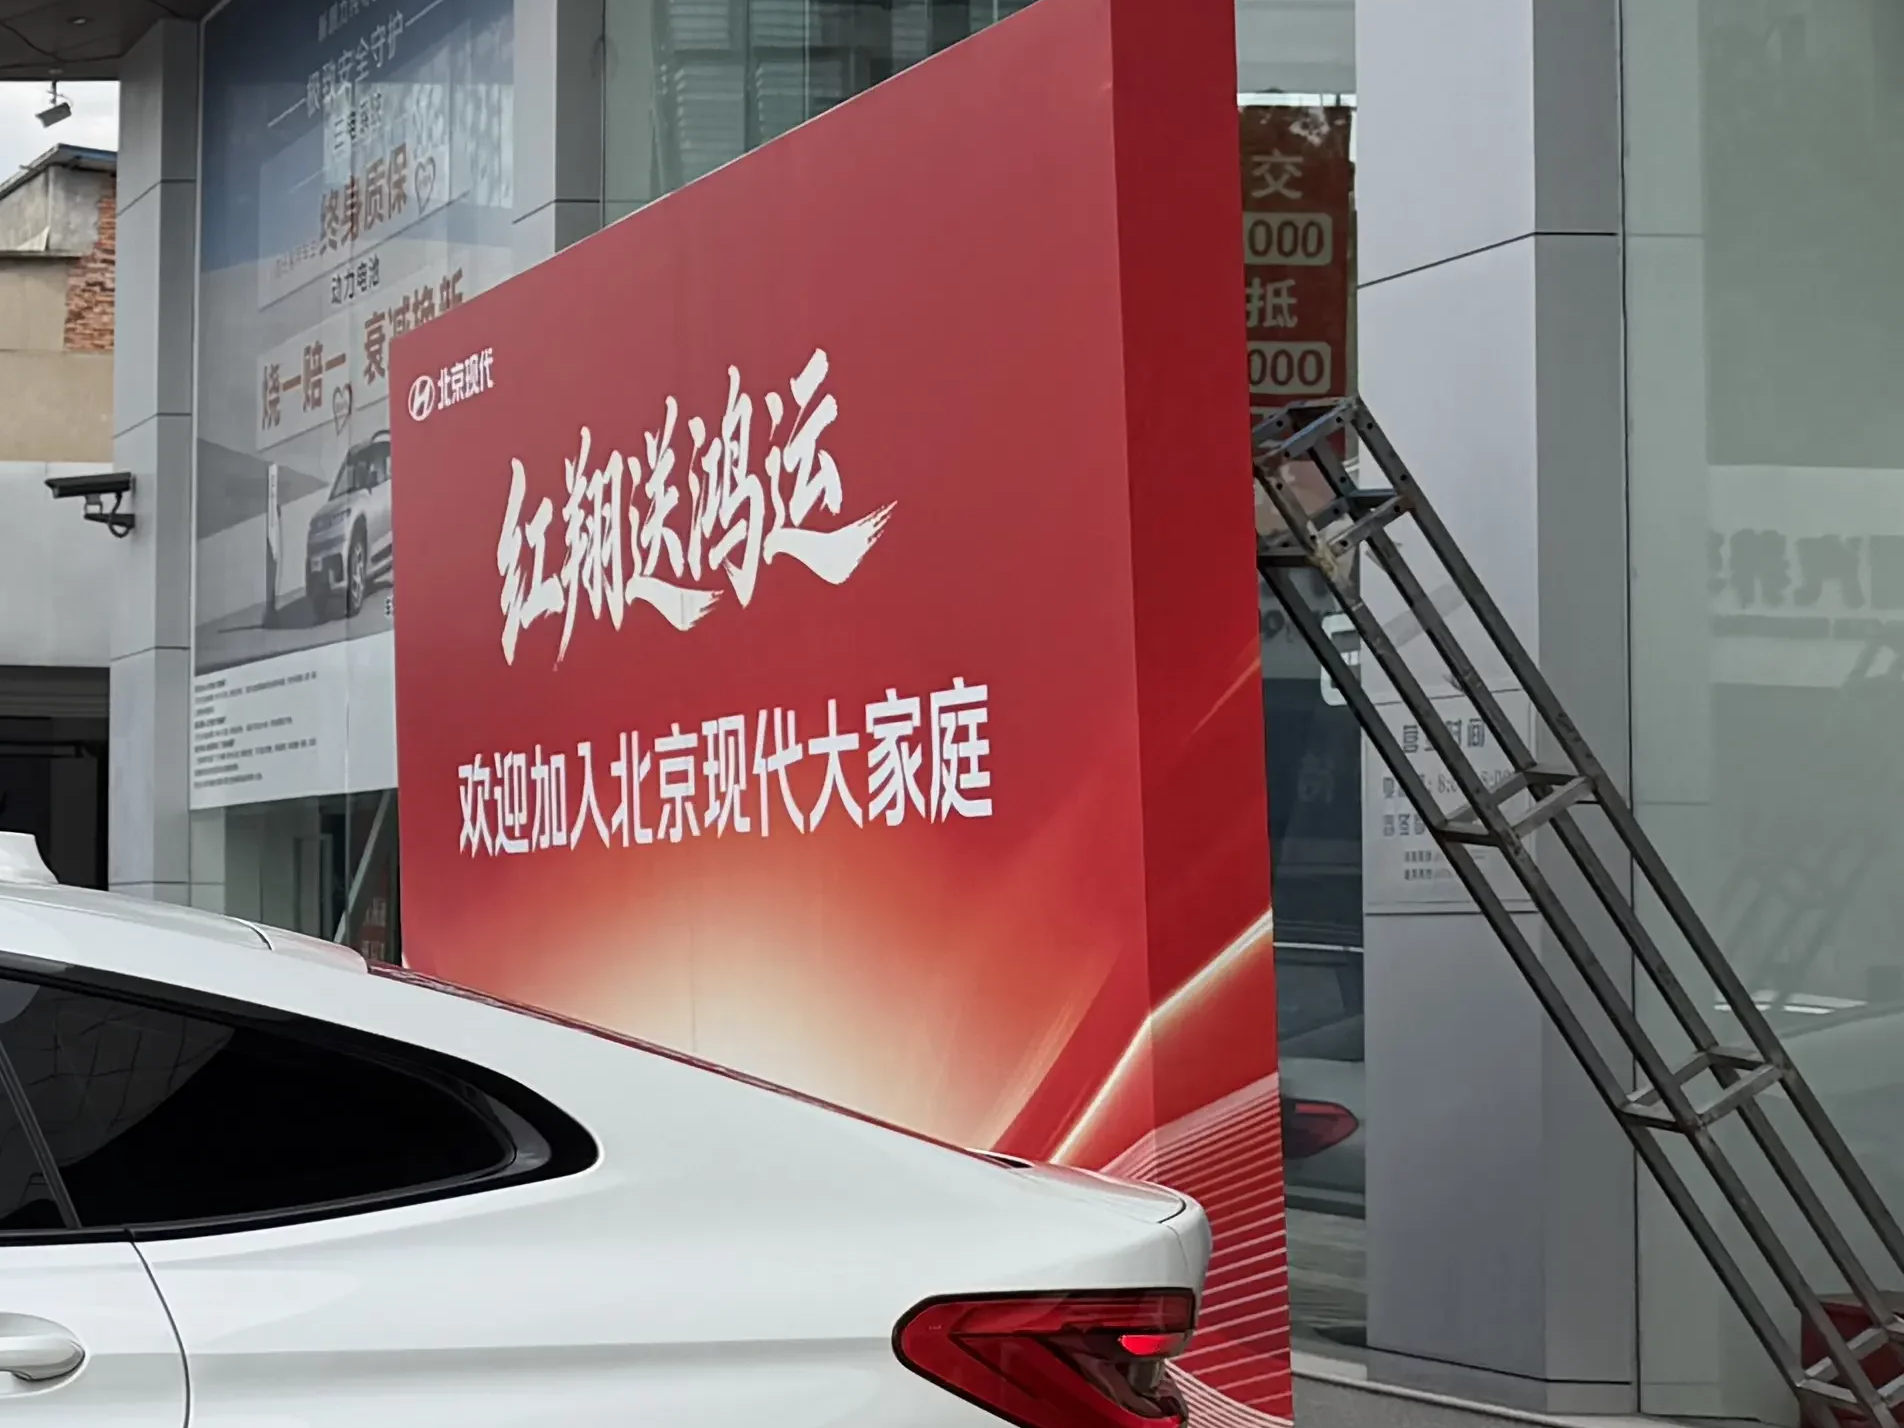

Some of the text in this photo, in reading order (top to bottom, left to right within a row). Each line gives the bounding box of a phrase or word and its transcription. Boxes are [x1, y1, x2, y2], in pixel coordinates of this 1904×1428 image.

[320, 142, 407, 256] 终身质保
[331, 253, 380, 304] 动力电池
[262, 340, 347, 430] 烧一赔一
[437, 347, 494, 410] 北京现代
[497, 348, 898, 671] 红翔送鸿运
[458, 677, 993, 858] 欢迎加入北京现代大家庭
